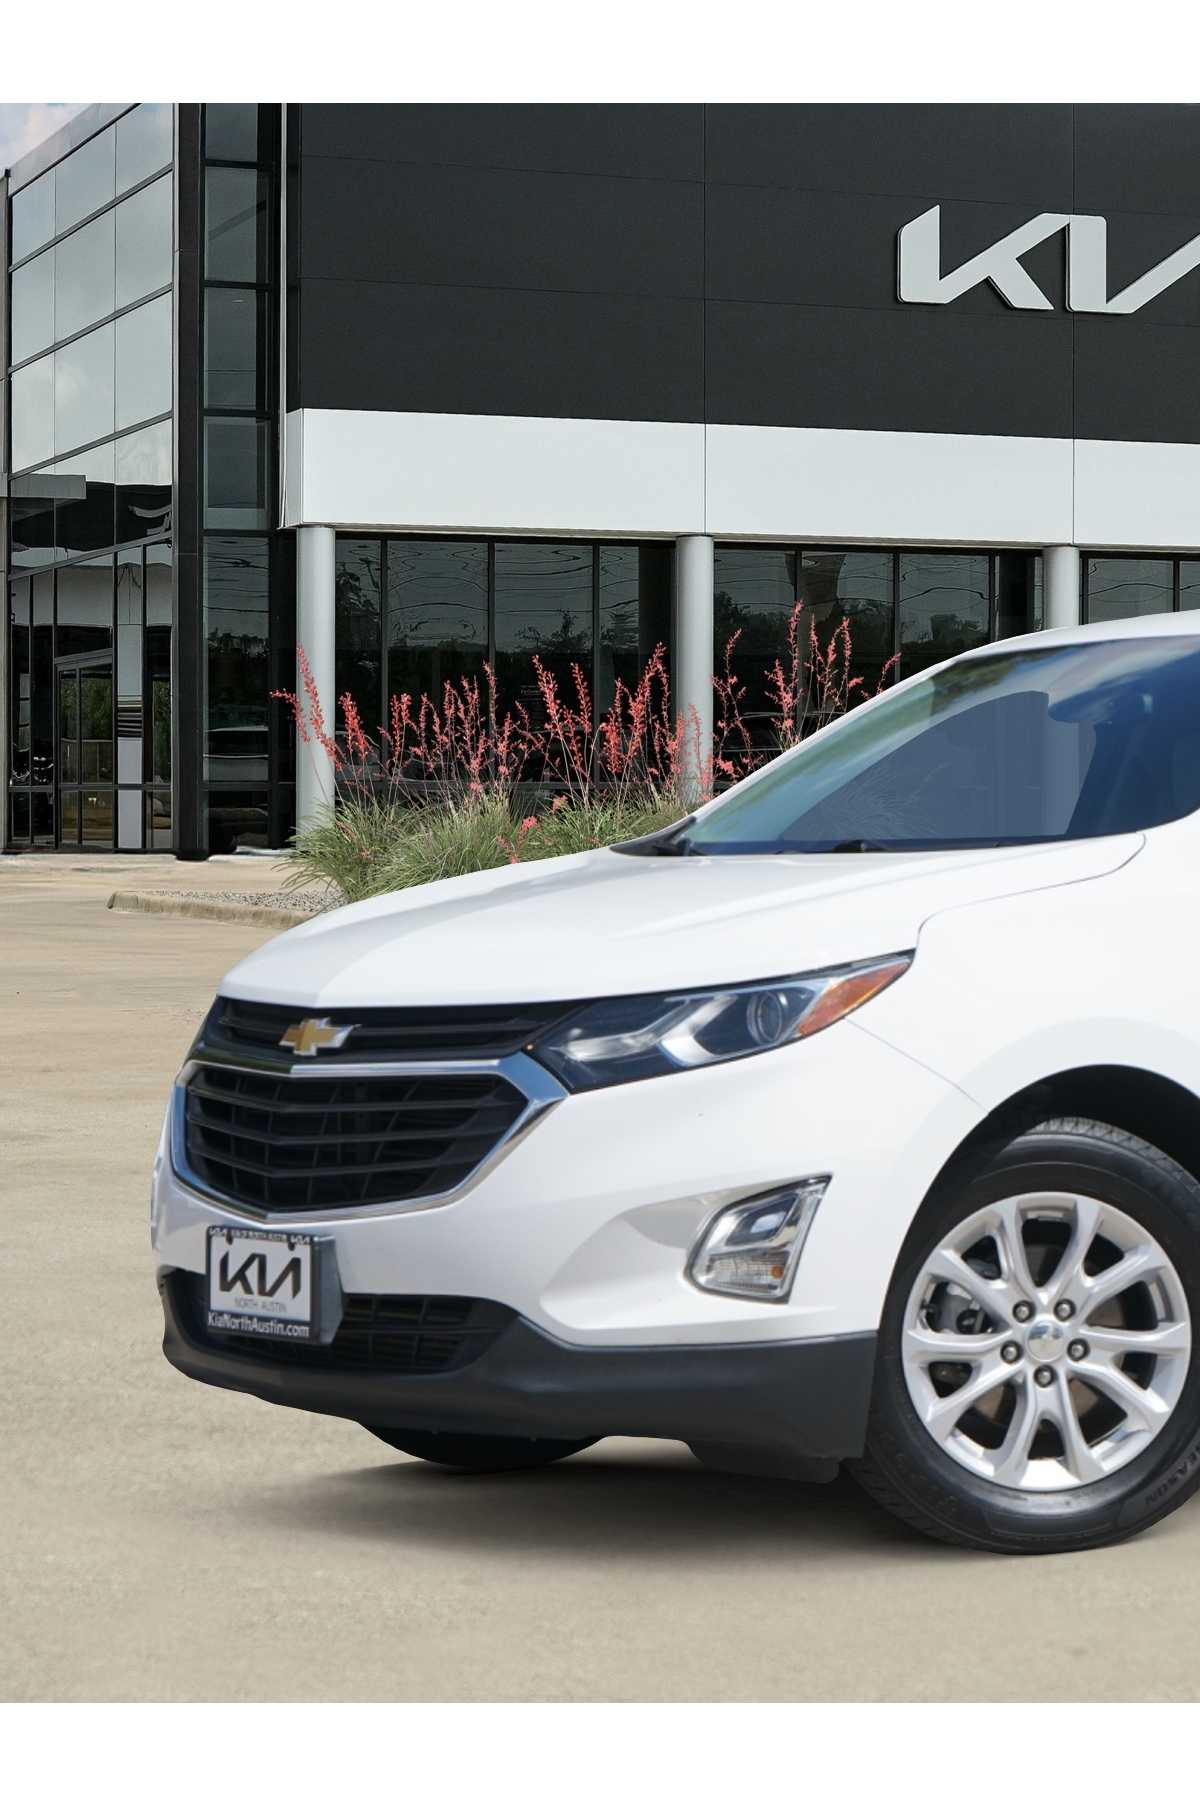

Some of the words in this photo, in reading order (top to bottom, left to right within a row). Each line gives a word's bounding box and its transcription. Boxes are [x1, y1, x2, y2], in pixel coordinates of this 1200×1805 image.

[219, 1250, 302, 1299] KIA
[234, 1297, 259, 1309] NORTH
[260, 1301, 288, 1313] AUSTIN
[208, 1311, 311, 1337] KiaNorthAustin.com
